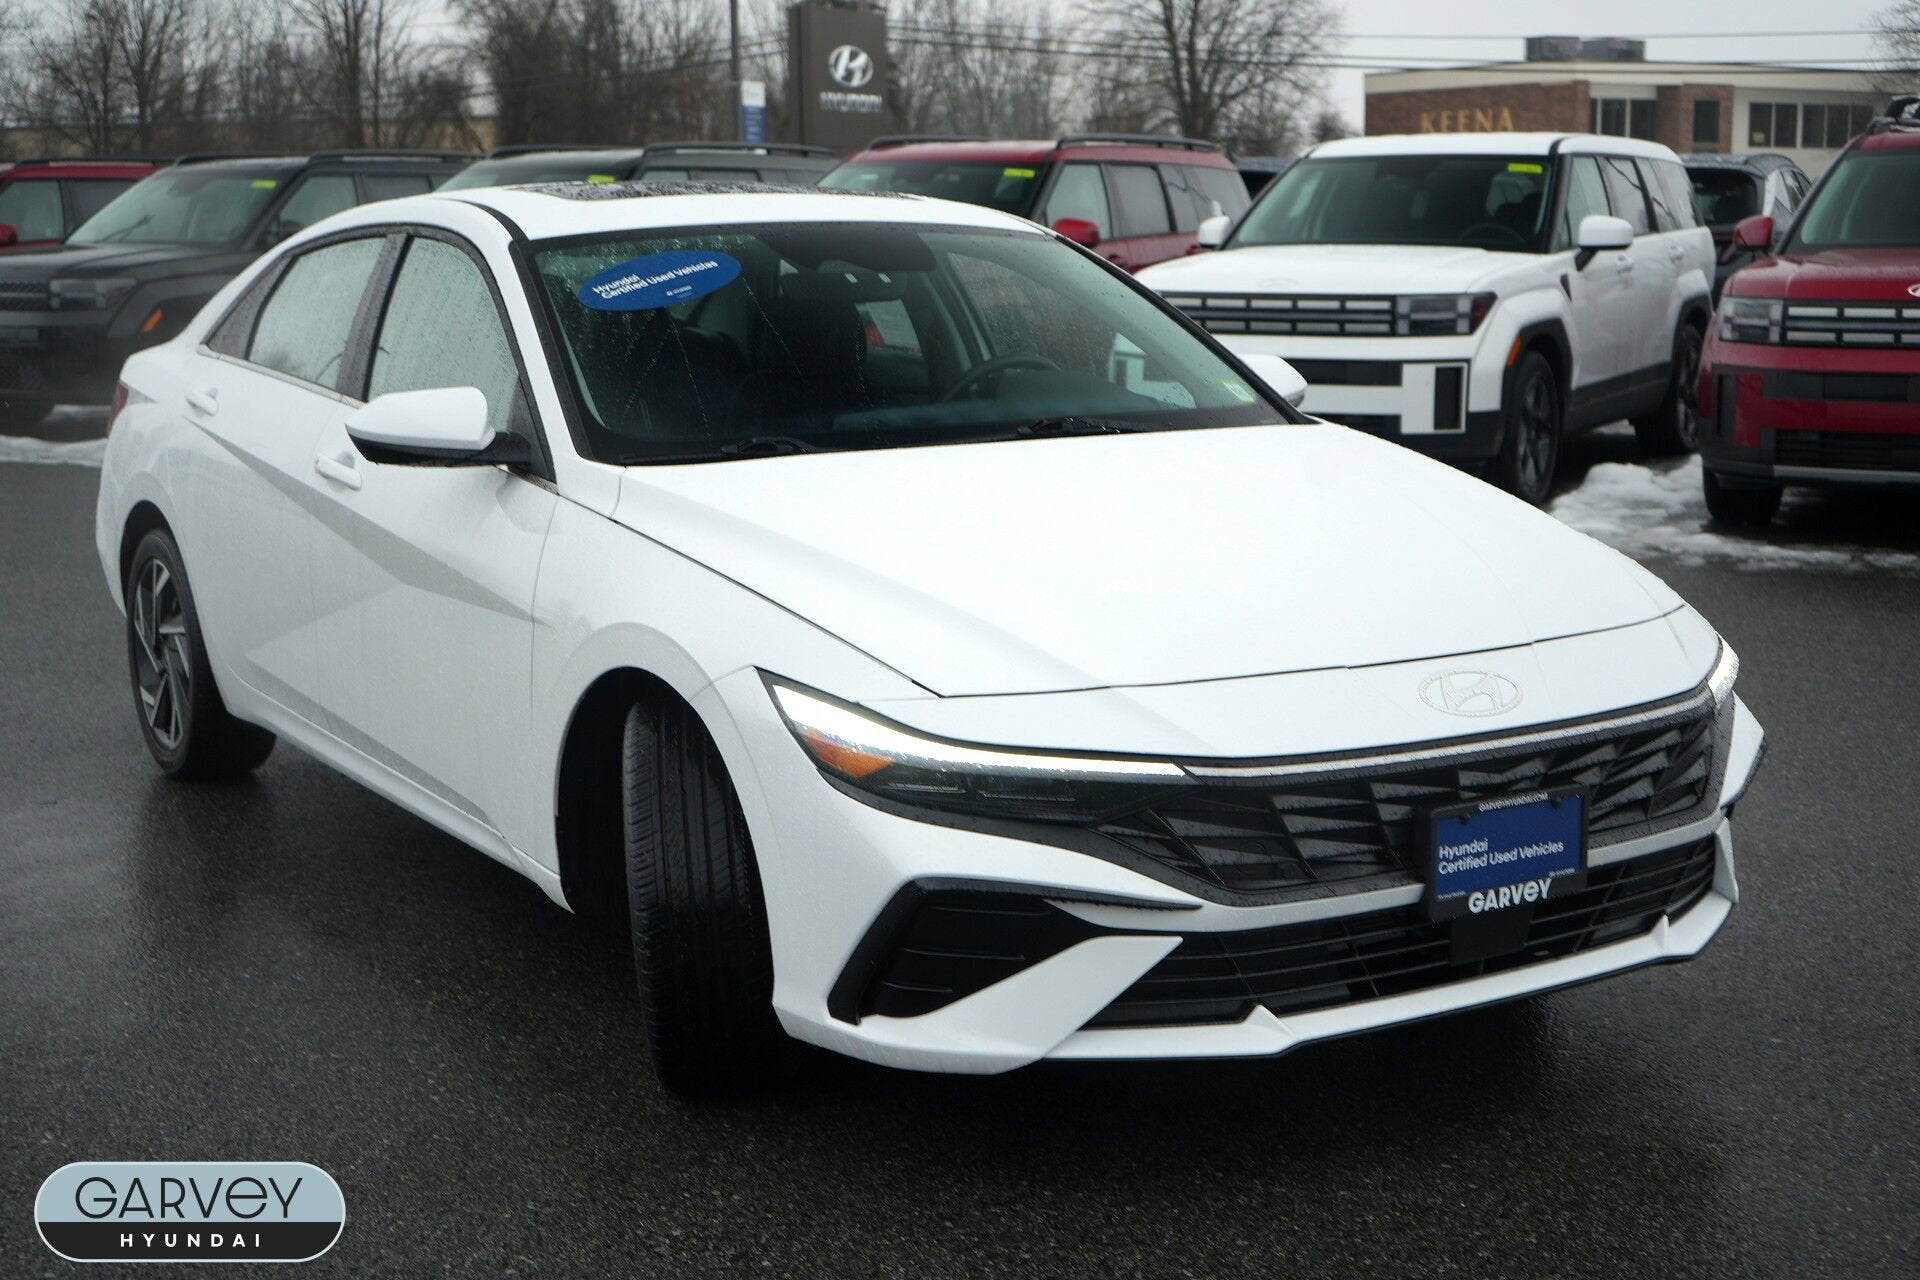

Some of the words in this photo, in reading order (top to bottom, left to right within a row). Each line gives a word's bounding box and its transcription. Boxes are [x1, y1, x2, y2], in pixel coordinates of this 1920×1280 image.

[1421, 106, 1514, 133] KEENA
[592, 274, 639, 293] Hyundai
[602, 279, 648, 298] Certified
[648, 271, 676, 285] Used
[676, 260, 718, 277] Vehicles
[1438, 855, 1487, 875] Certified
[1489, 848, 1518, 865] Used
[1519, 841, 1564, 859] Vehicles
[1439, 838, 1488, 859] Hyundai
